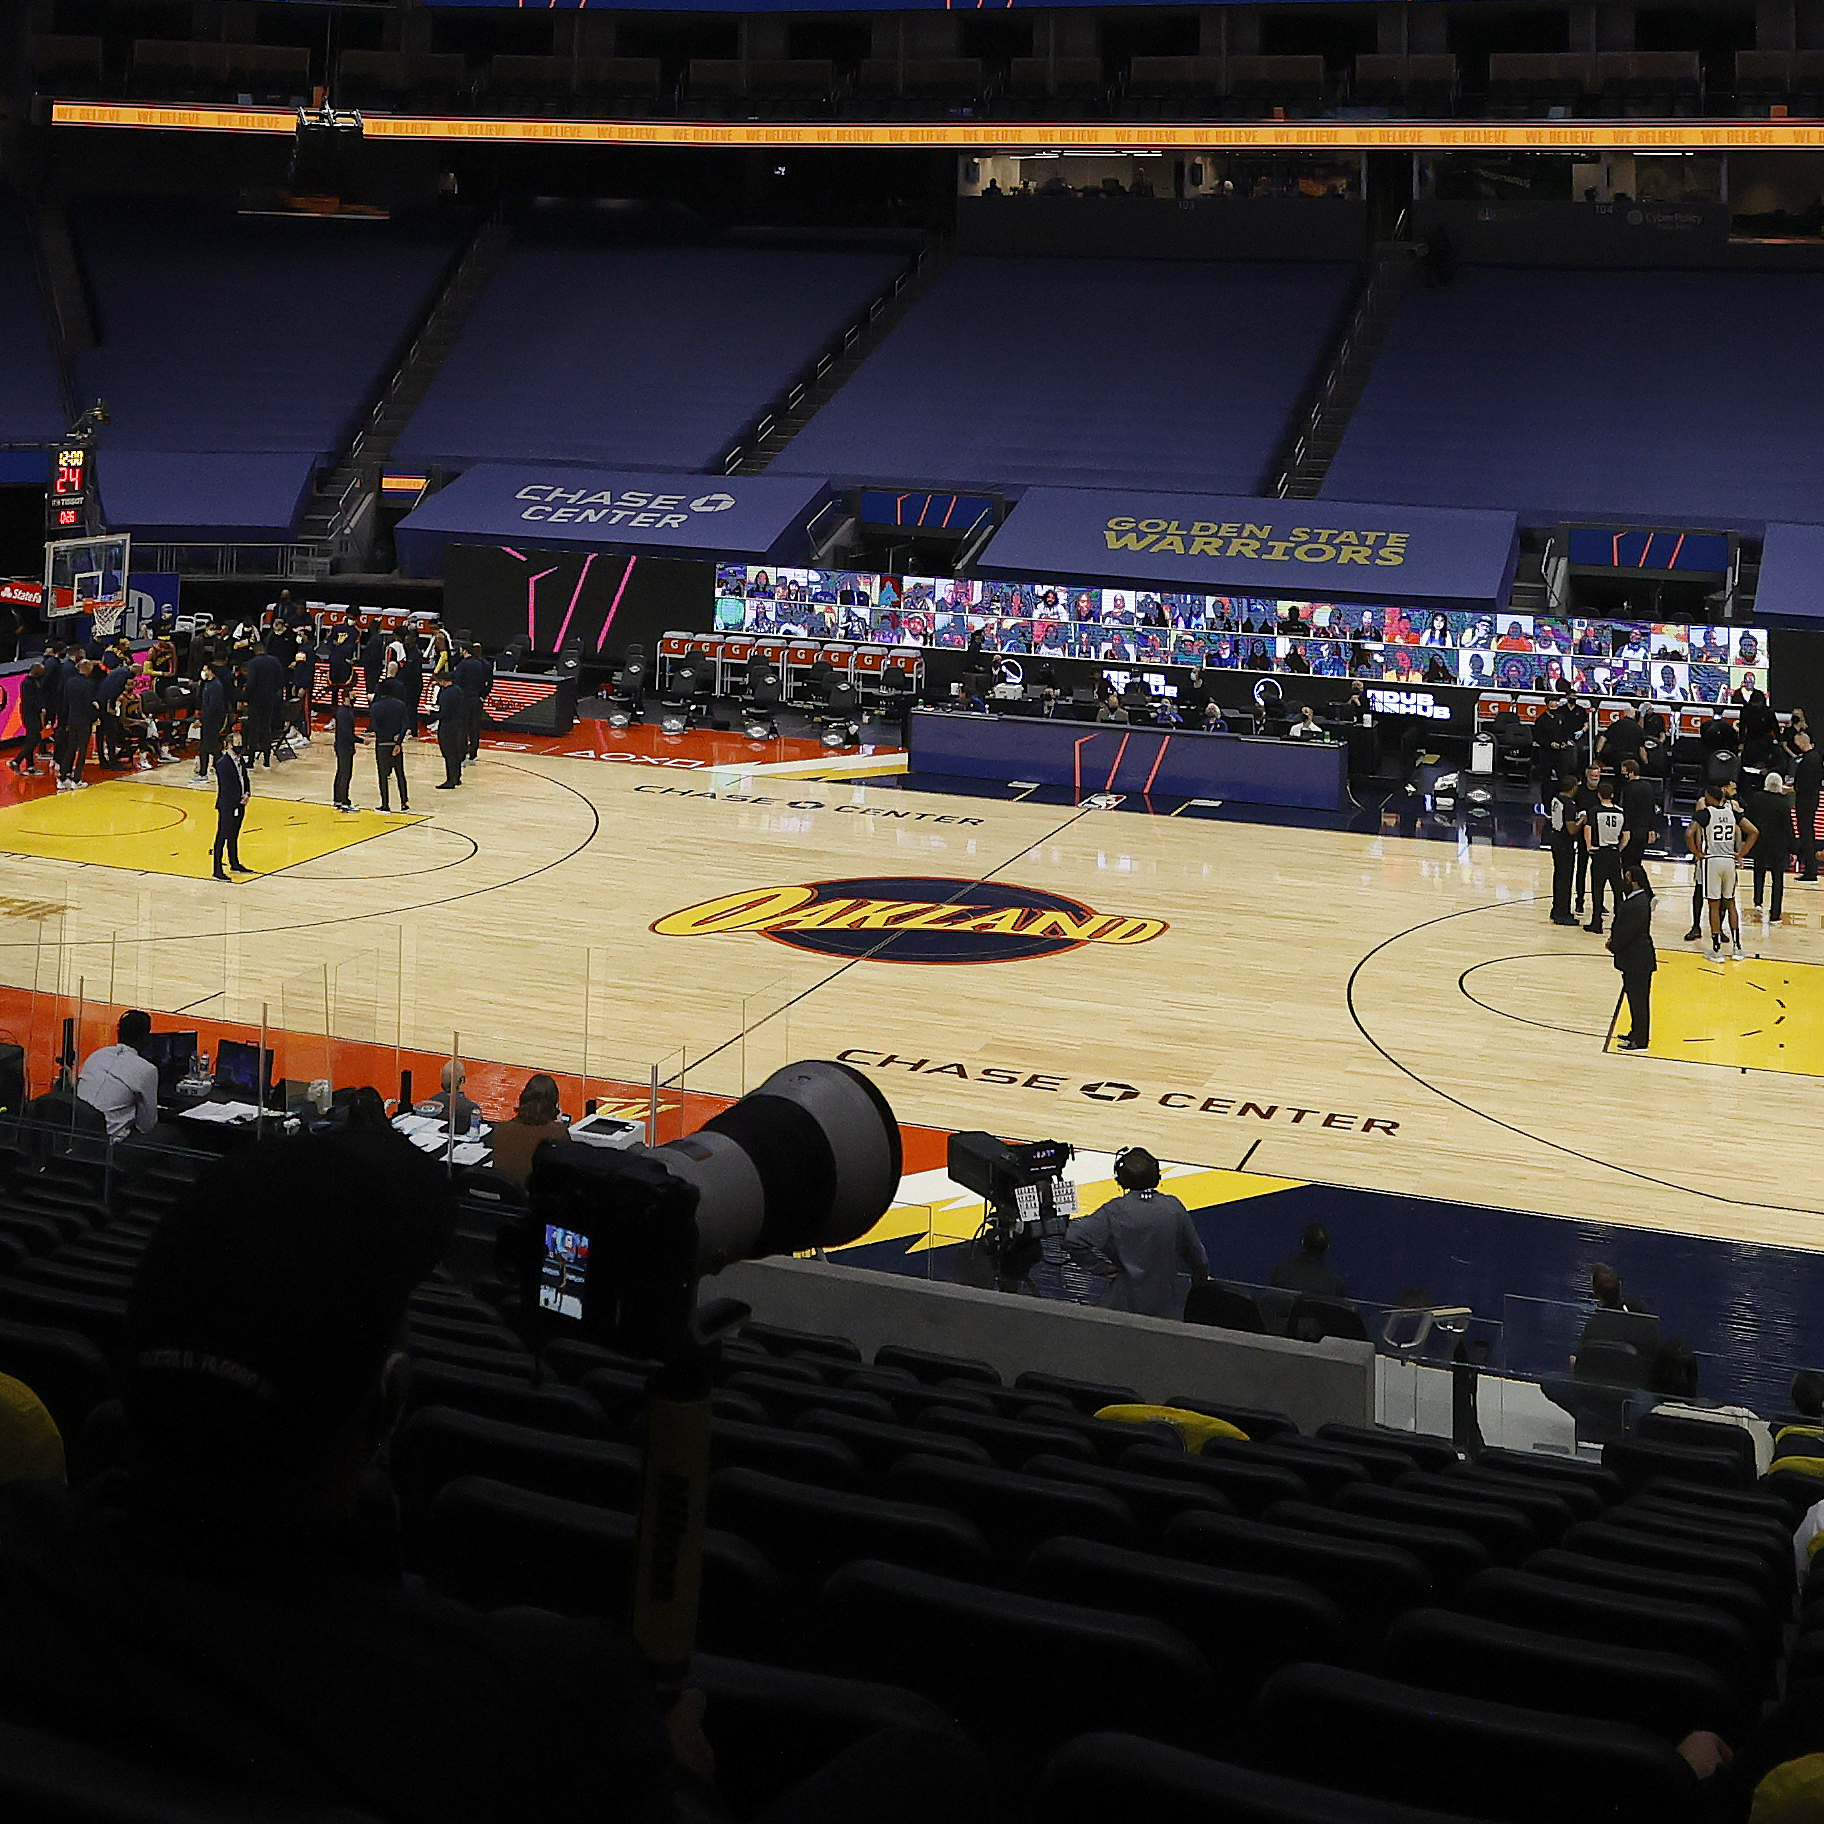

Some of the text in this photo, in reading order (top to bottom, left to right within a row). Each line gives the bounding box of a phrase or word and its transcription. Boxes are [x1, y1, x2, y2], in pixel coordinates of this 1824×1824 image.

[515, 485, 686, 510] CHASE
[522, 506, 688, 528] CENTER
[1107, 517, 1409, 547] GOLDEN STATE
[1104, 531, 1404, 565] WARRIORS
[634, 785, 985, 825] CHASE CENTER
[1606, 816, 1617, 828] 46
[1713, 826, 1733, 841] 22
[649, 886, 1170, 945] OAKLAND
[836, 1049, 1400, 1137] CHASE CENTER
